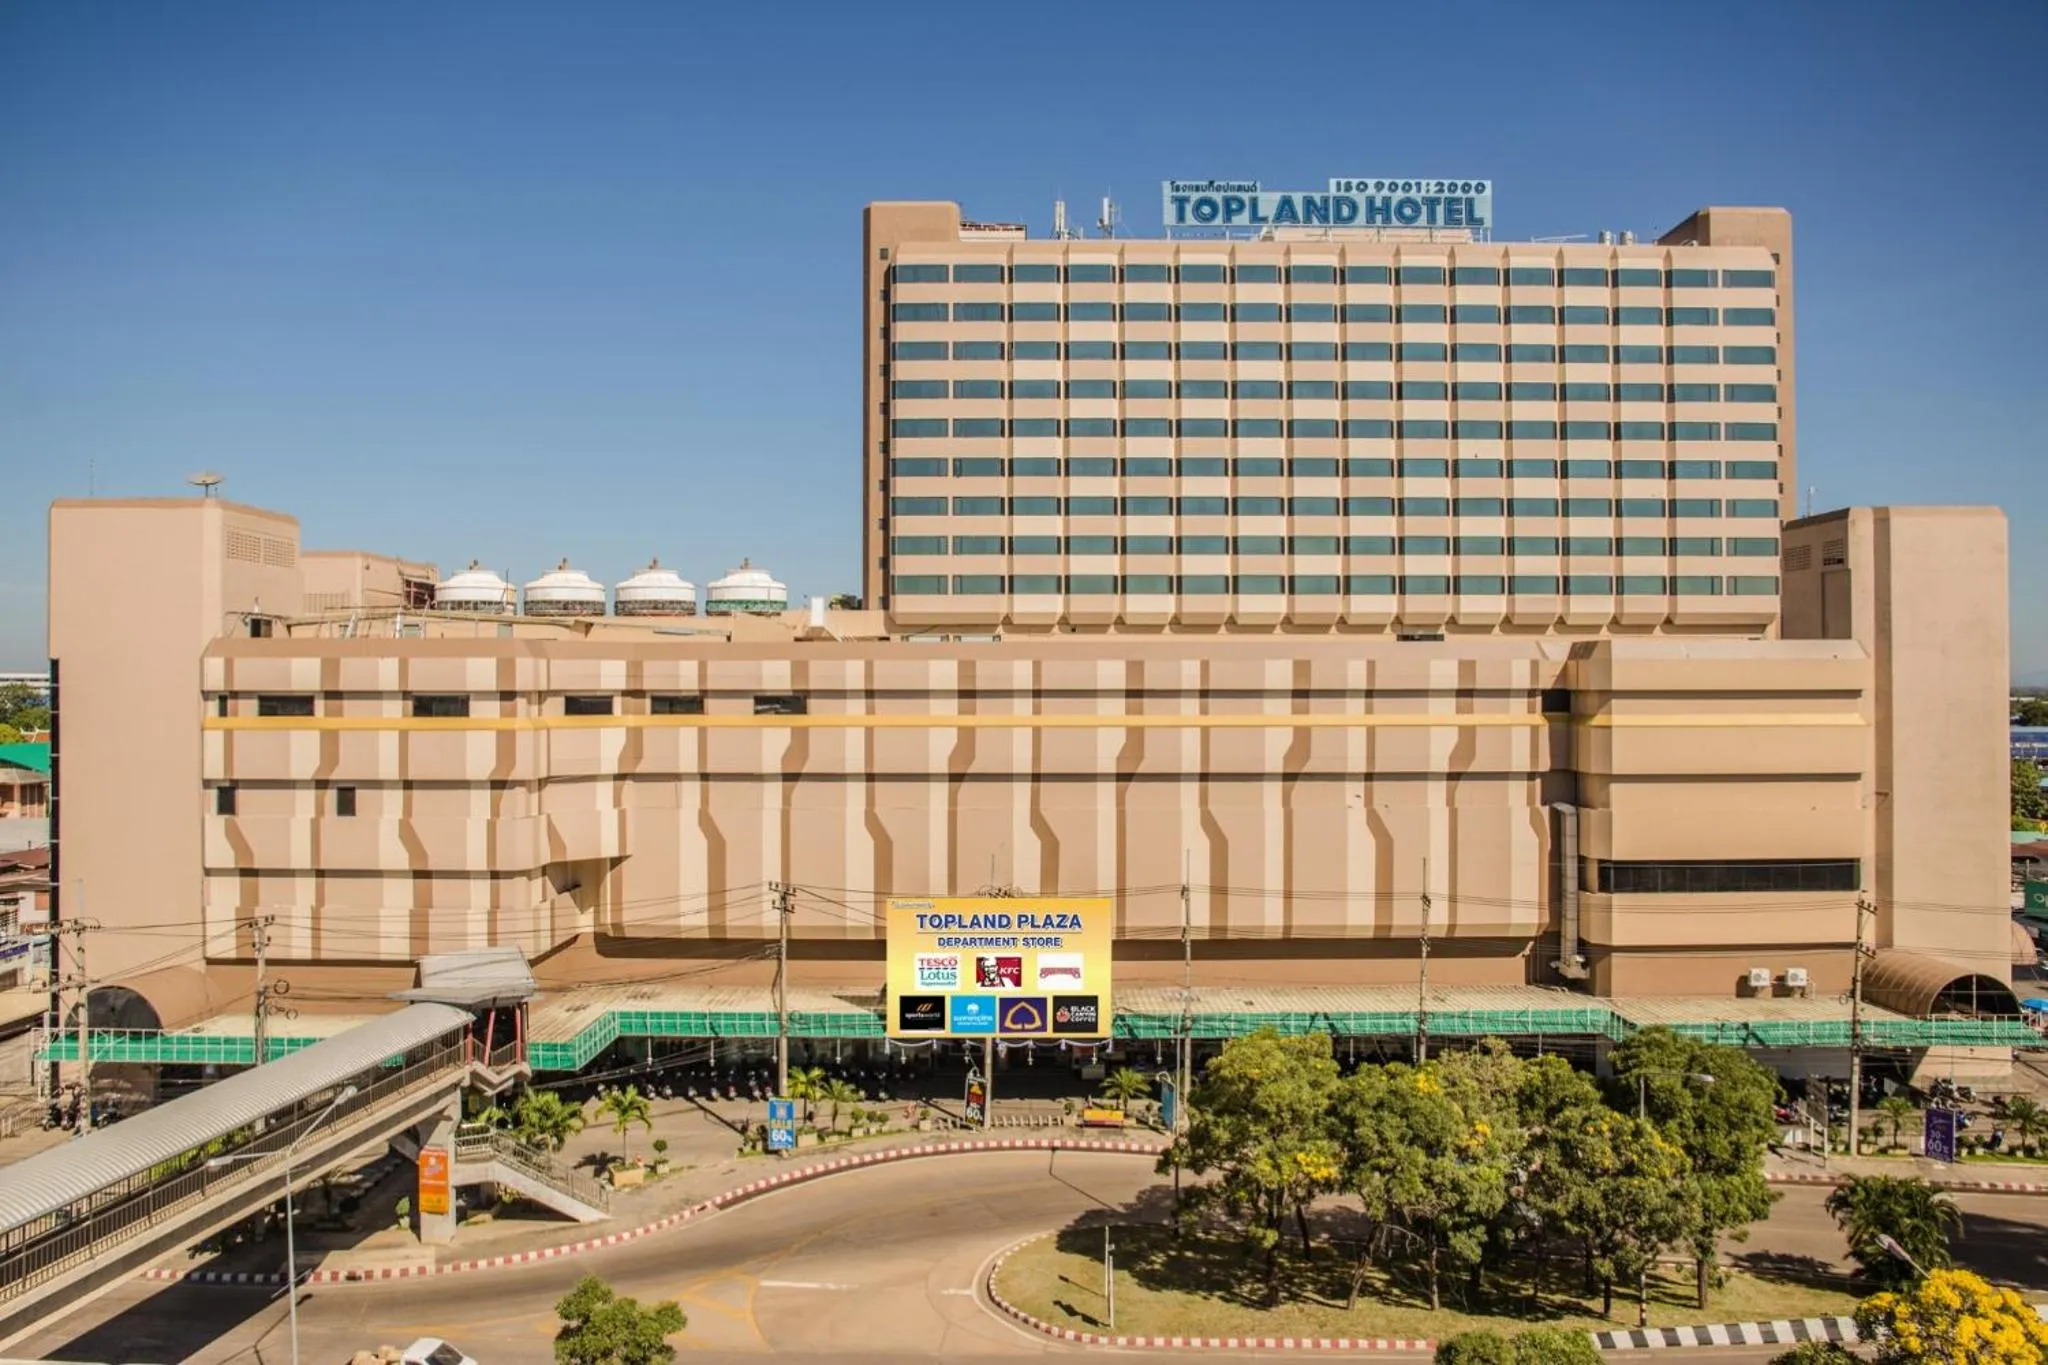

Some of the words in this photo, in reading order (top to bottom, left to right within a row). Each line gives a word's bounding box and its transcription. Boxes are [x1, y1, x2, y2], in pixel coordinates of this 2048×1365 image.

[1336, 181, 1369, 193] ISO
[1374, 181, 1487, 195] 9001:2000
[1171, 195, 1359, 224] TOPLAND
[1366, 196, 1485, 226] HOTEL
[916, 914, 1012, 930] TOPLAND
[1017, 914, 1082, 930] PLAZA
[938, 937, 1019, 948] DEPARTMENT
[1022, 937, 1062, 948] STORE
[918, 957, 957, 967] TESCO
[920, 970, 957, 981] Lotus
[1000, 967, 1020, 975] KFC
